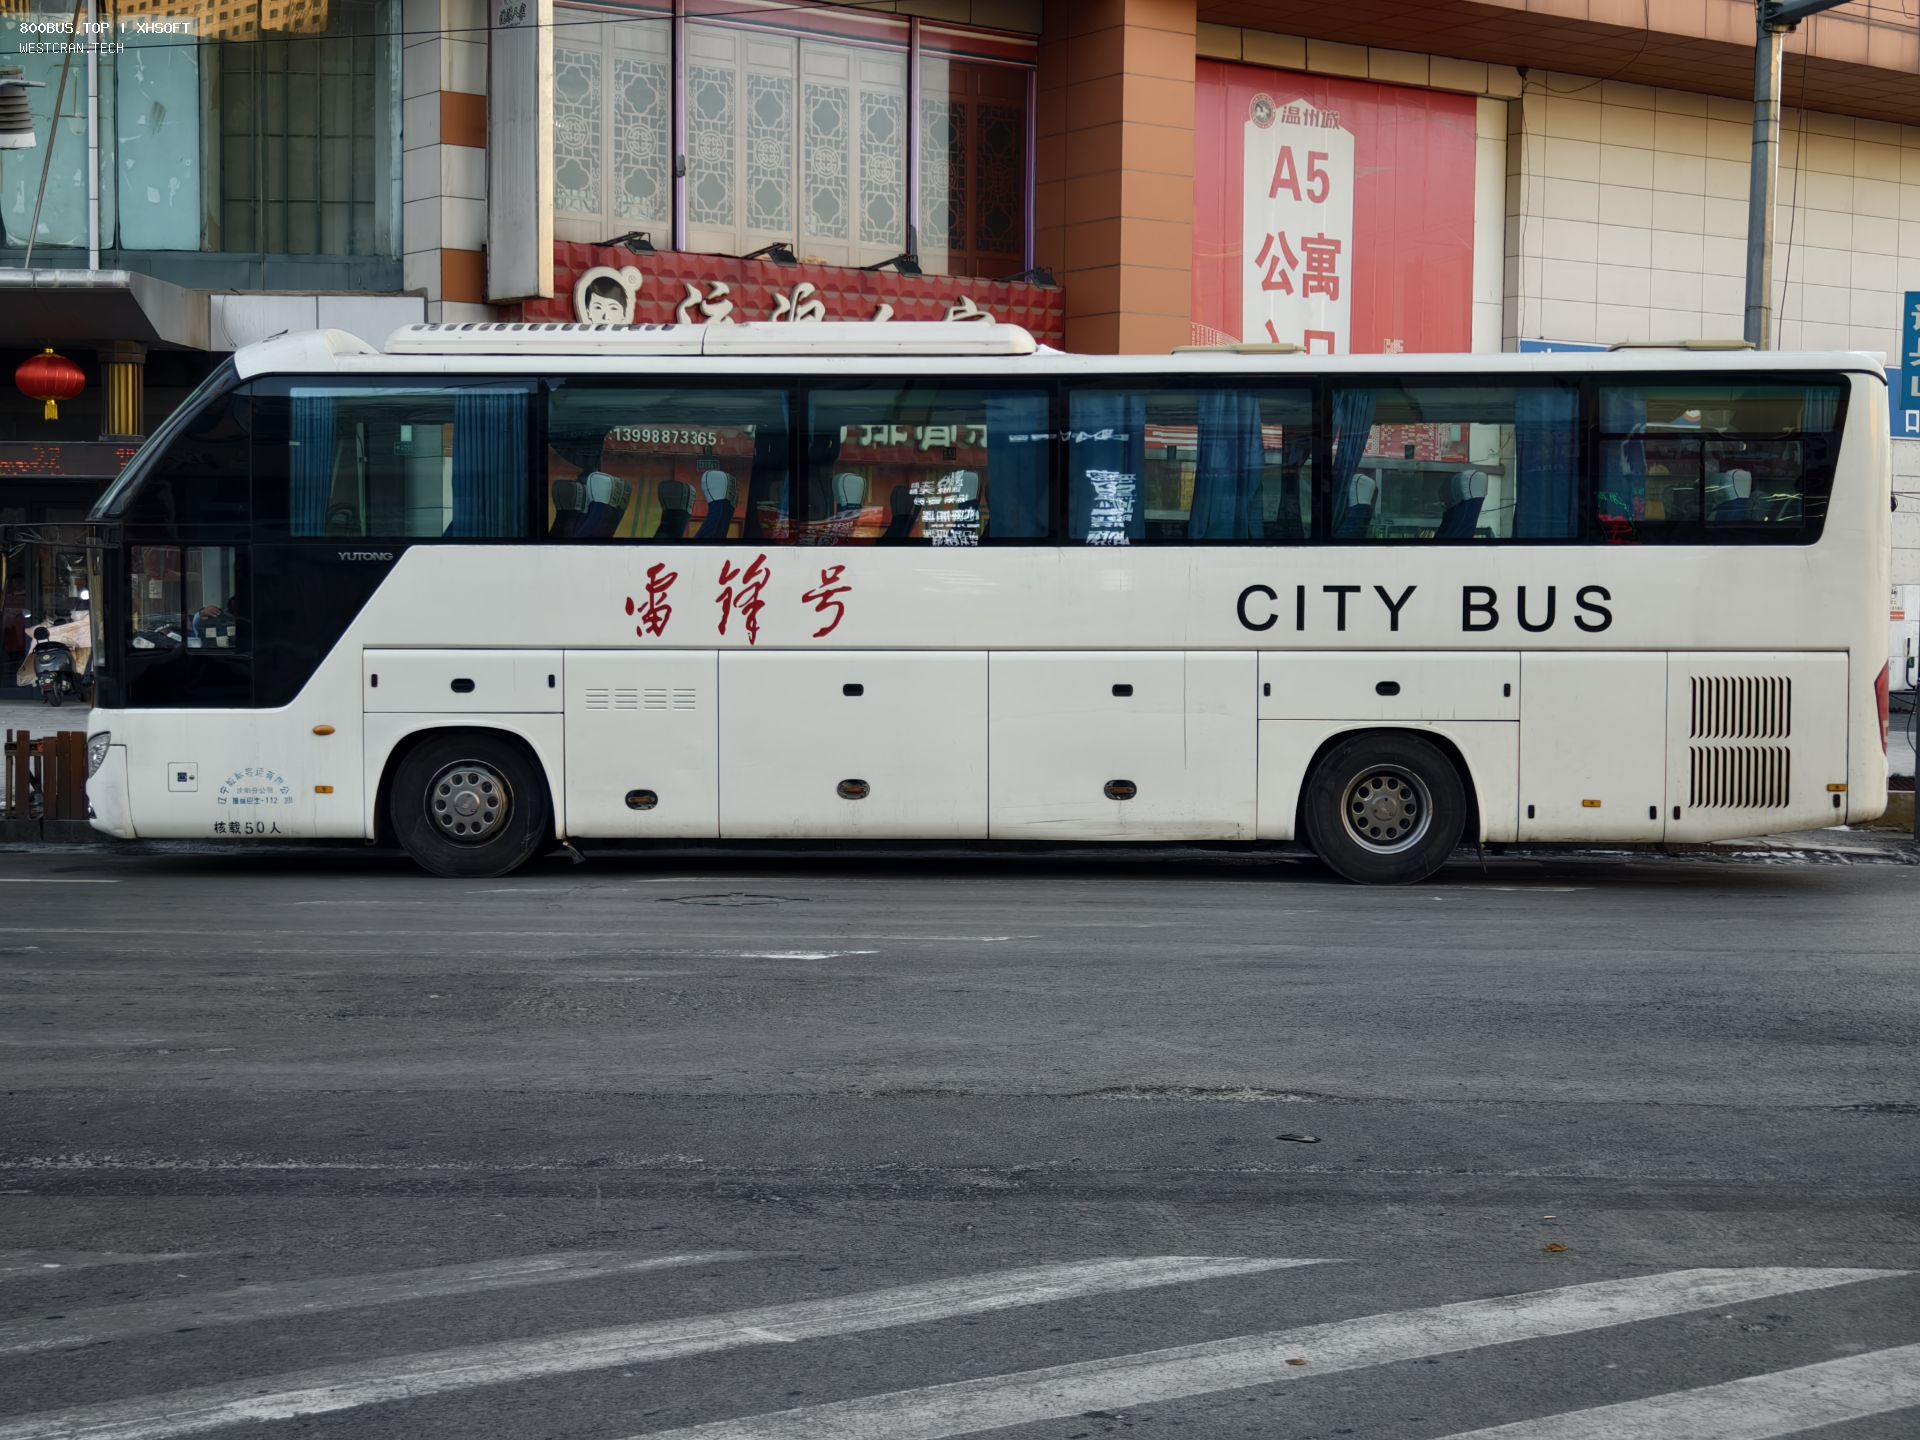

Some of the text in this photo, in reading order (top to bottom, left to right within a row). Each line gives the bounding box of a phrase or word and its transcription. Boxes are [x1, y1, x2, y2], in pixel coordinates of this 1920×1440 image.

[1281, 106, 1340, 130] 温州城
[1268, 145, 1330, 204] A5
[1254, 231, 1342, 302] 公寓
[614, 428, 717, 446] 13998873365
[337, 551, 394, 561] YUTONG
[625, 553, 853, 646] 雷锋号
[1236, 584, 1614, 633] CITY BUS
[213, 820, 282, 835] 核载50人
